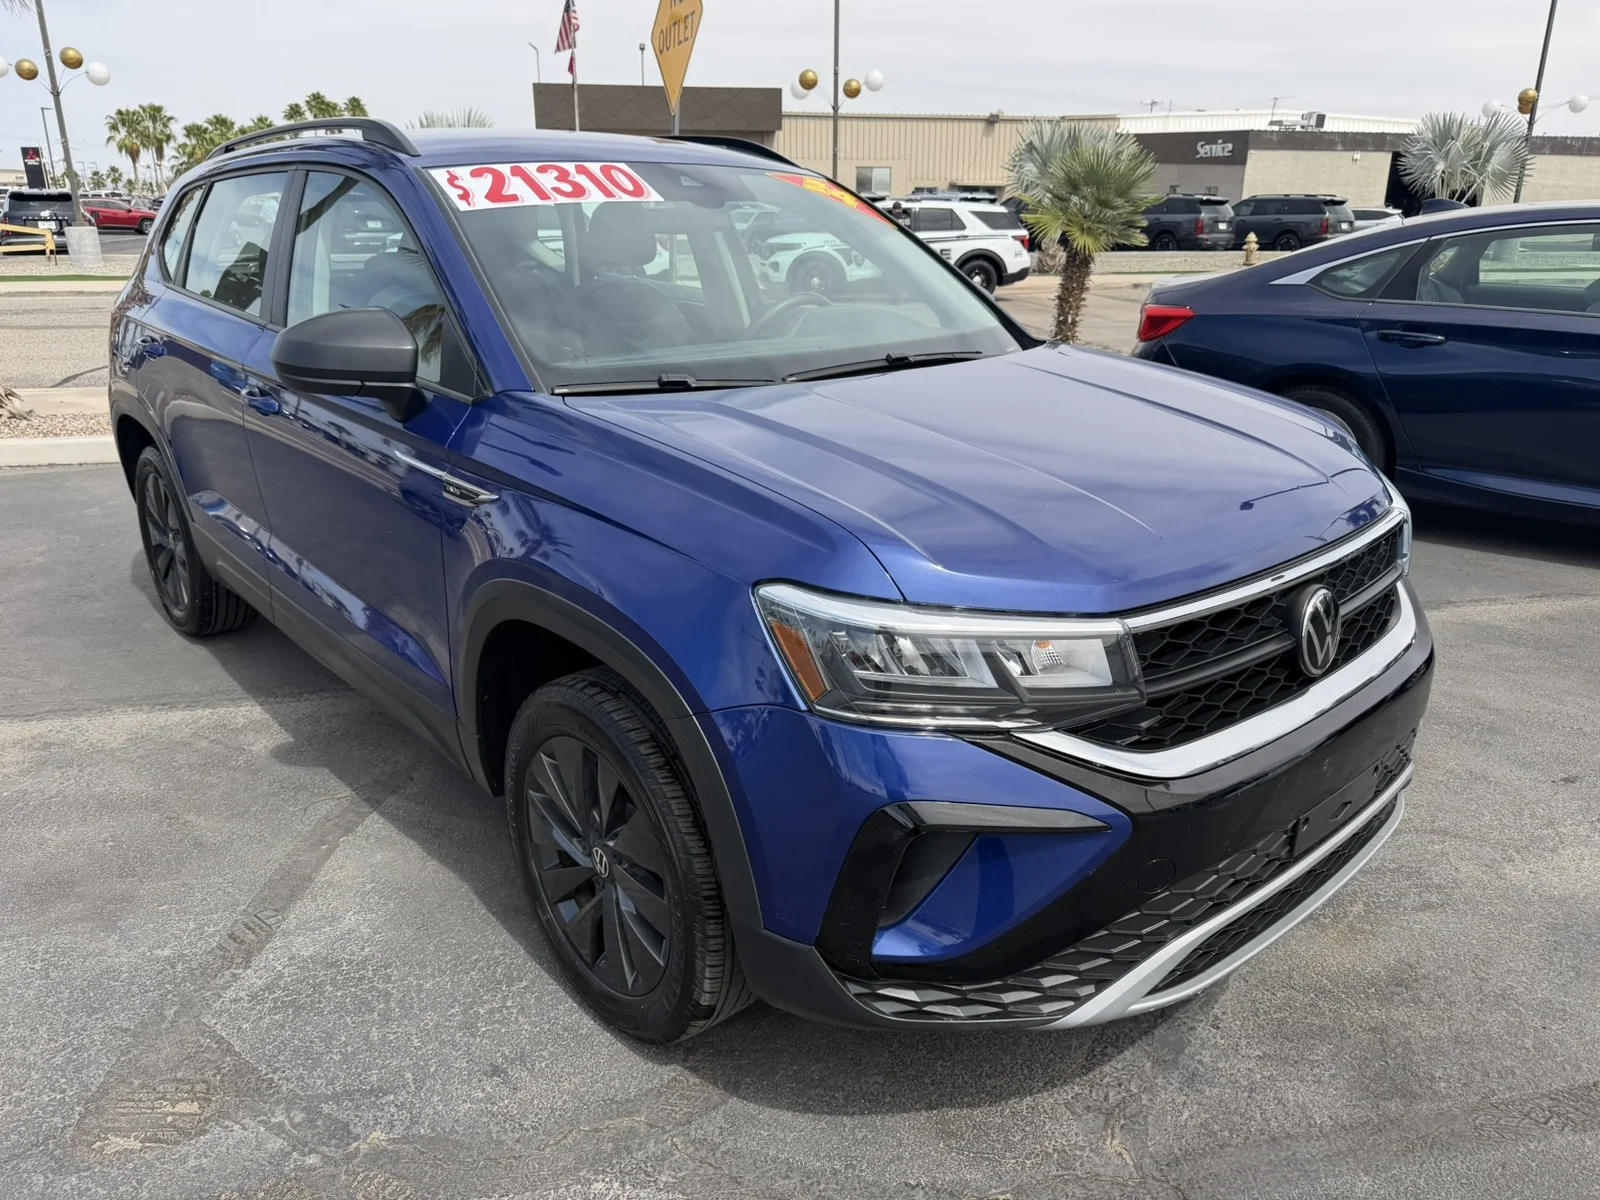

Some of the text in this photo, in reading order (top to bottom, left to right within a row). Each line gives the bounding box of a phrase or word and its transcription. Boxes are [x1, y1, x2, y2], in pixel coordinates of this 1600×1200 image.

[658, 10, 696, 56] OUTLET
[1195, 139, 1233, 159] Service
[446, 163, 649, 207] $21310
